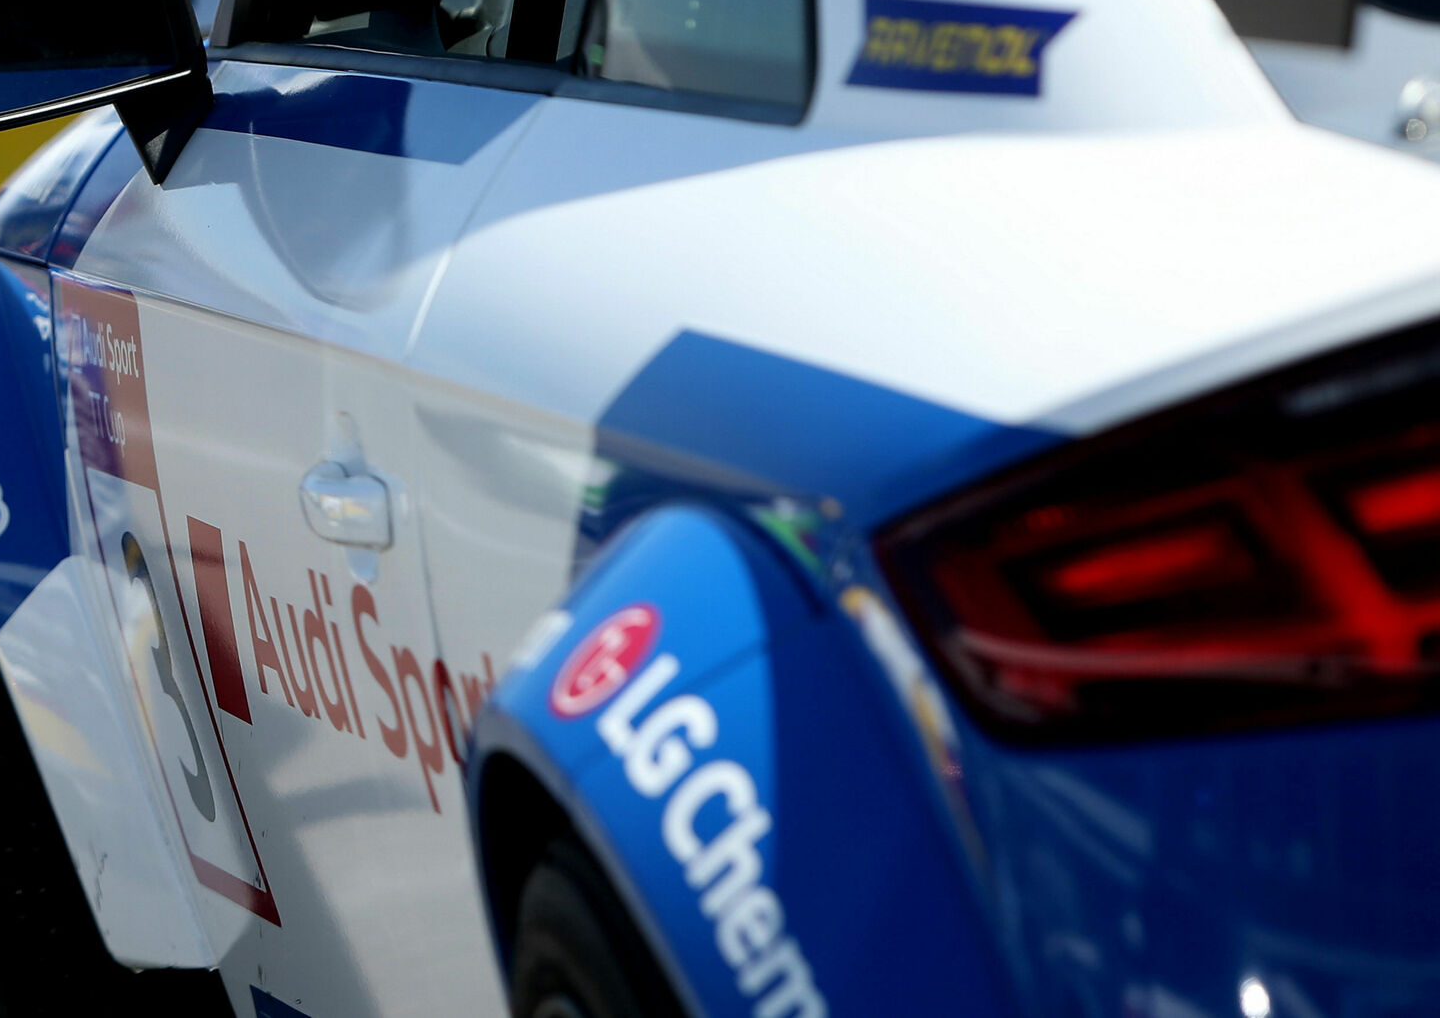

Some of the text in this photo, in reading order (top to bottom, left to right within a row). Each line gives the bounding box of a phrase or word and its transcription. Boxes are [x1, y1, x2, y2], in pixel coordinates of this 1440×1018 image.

[81, 318, 139, 385] Audi Sport
[88, 390, 126, 458] TT Cup
[121, 530, 216, 823] 3
[238, 539, 366, 740] Audi
